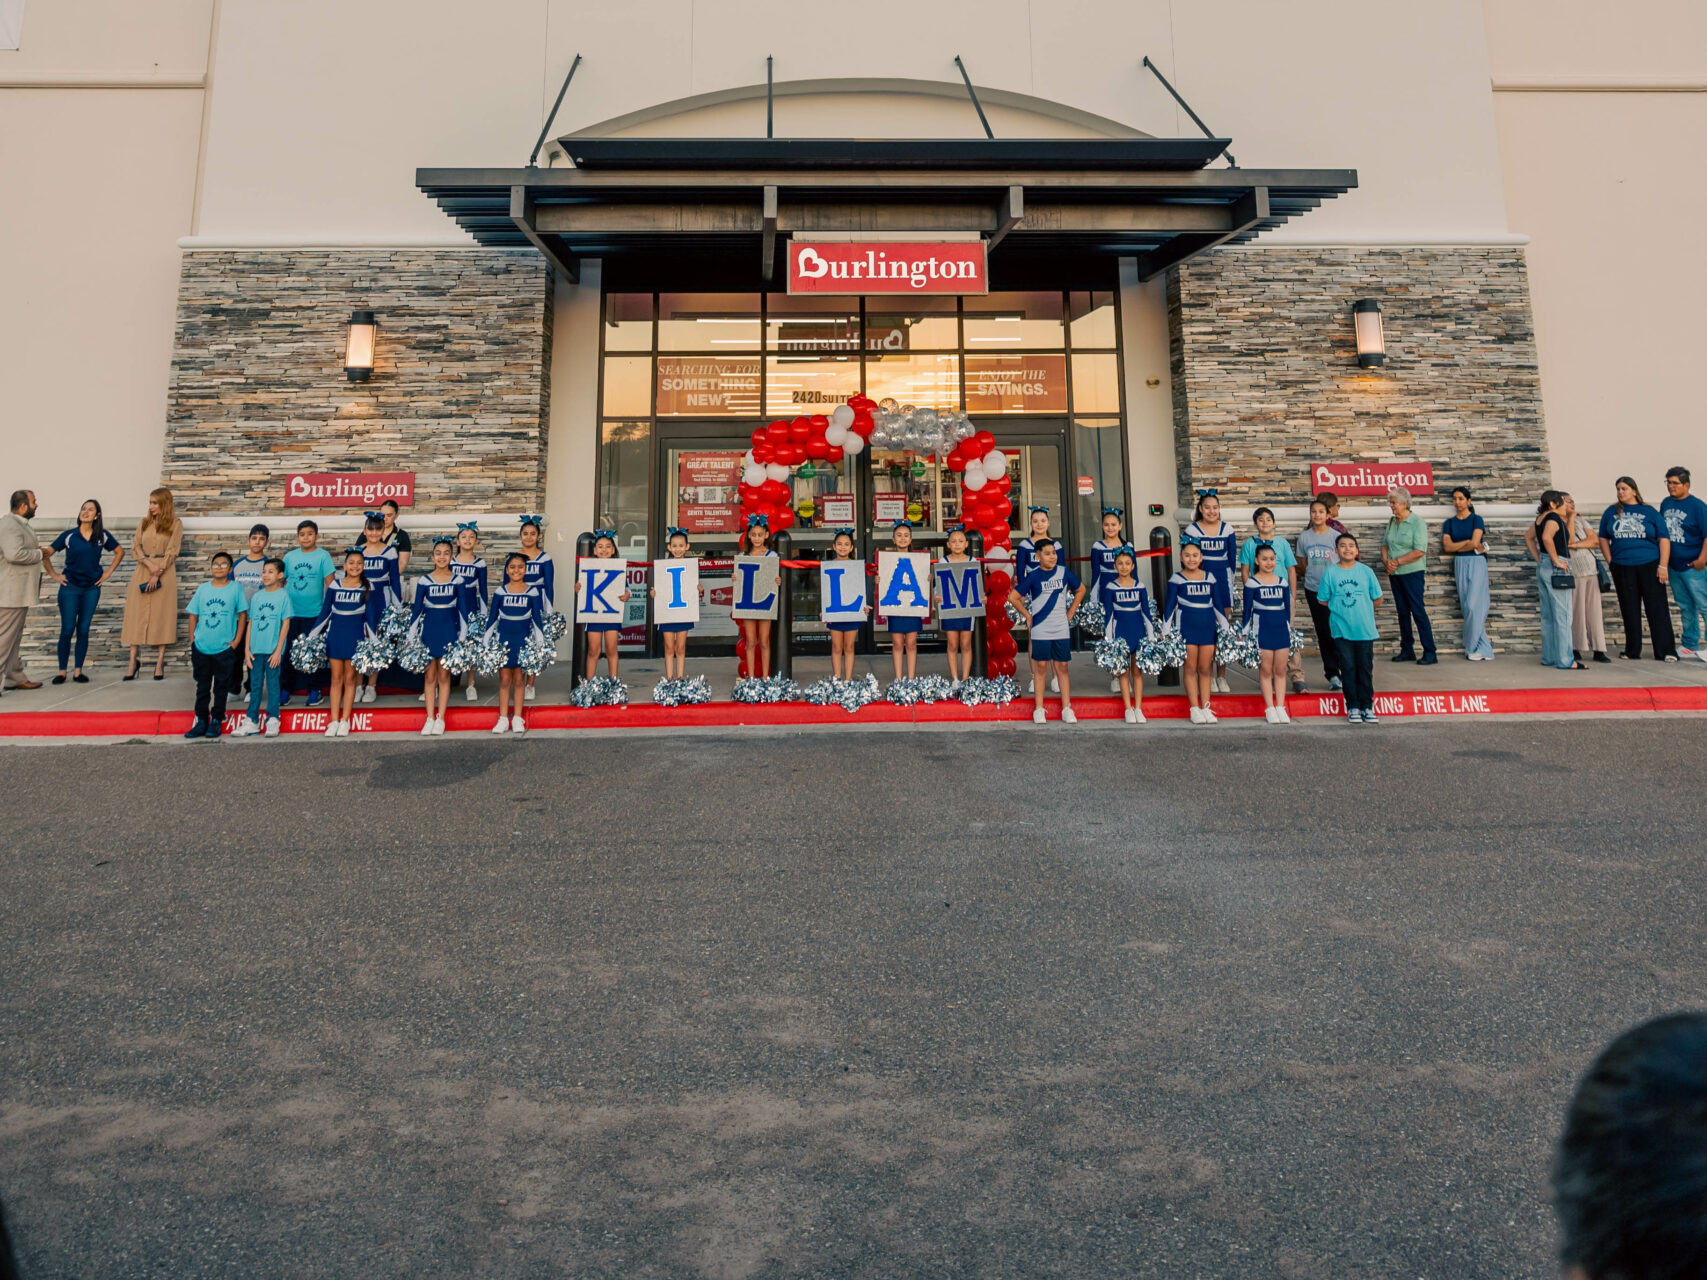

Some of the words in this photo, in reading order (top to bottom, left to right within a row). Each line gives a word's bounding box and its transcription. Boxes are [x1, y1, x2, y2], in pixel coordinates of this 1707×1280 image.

[798, 247, 977, 289] Burlington
[658, 364, 731, 375] SEARCHING
[735, 364, 761, 375] FOR
[1021, 369, 1047, 380] THE
[662, 378, 757, 391] SOMETHING
[978, 382, 1049, 396] SAVINGS.
[687, 393, 732, 406] NEW?
[792, 391, 821, 404] 2420
[1316, 466, 1430, 493] Burlington
[290, 476, 409, 503] Burlington
[1200, 539, 1225, 551] KILLAM
[428, 585, 454, 597] KILLAM
[1115, 589, 1141, 603] KILLAM
[1186, 583, 1212, 596] KILLAM
[1259, 586, 1284, 600] KILLAM
[335, 591, 361, 603] KILLAM
[503, 595, 529, 608] KILLAM
[1319, 697, 1340, 715] NO
[1413, 696, 1448, 714] FIRE
[1450, 695, 1491, 714] LANE
[291, 713, 328, 730] FIRE
